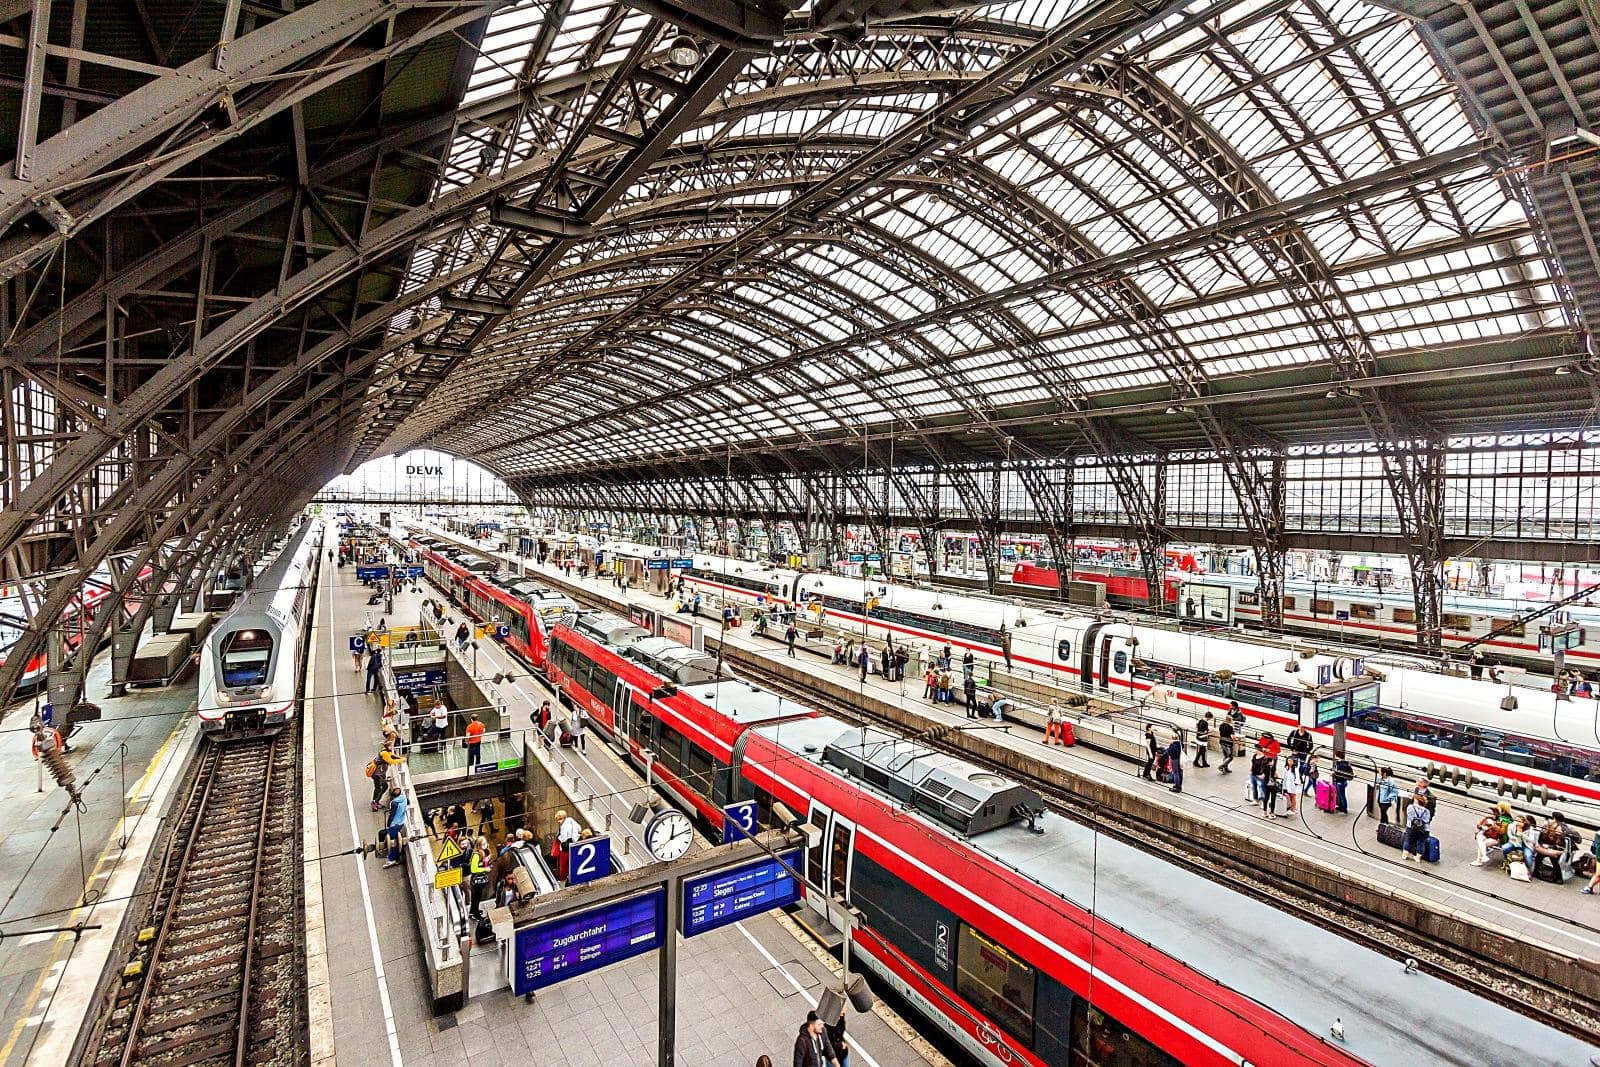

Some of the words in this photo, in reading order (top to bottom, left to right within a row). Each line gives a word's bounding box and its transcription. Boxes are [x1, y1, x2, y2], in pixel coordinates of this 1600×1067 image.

[406, 465, 443, 475] DEVK
[500, 626, 509, 636] C
[354, 636, 363, 648] C
[738, 806, 753, 832] 3
[577, 844, 596, 876] 2
[713, 886, 734, 897] Siegen
[552, 924, 607, 948] Zugdurchfahrt
[938, 925, 946, 943] 2
